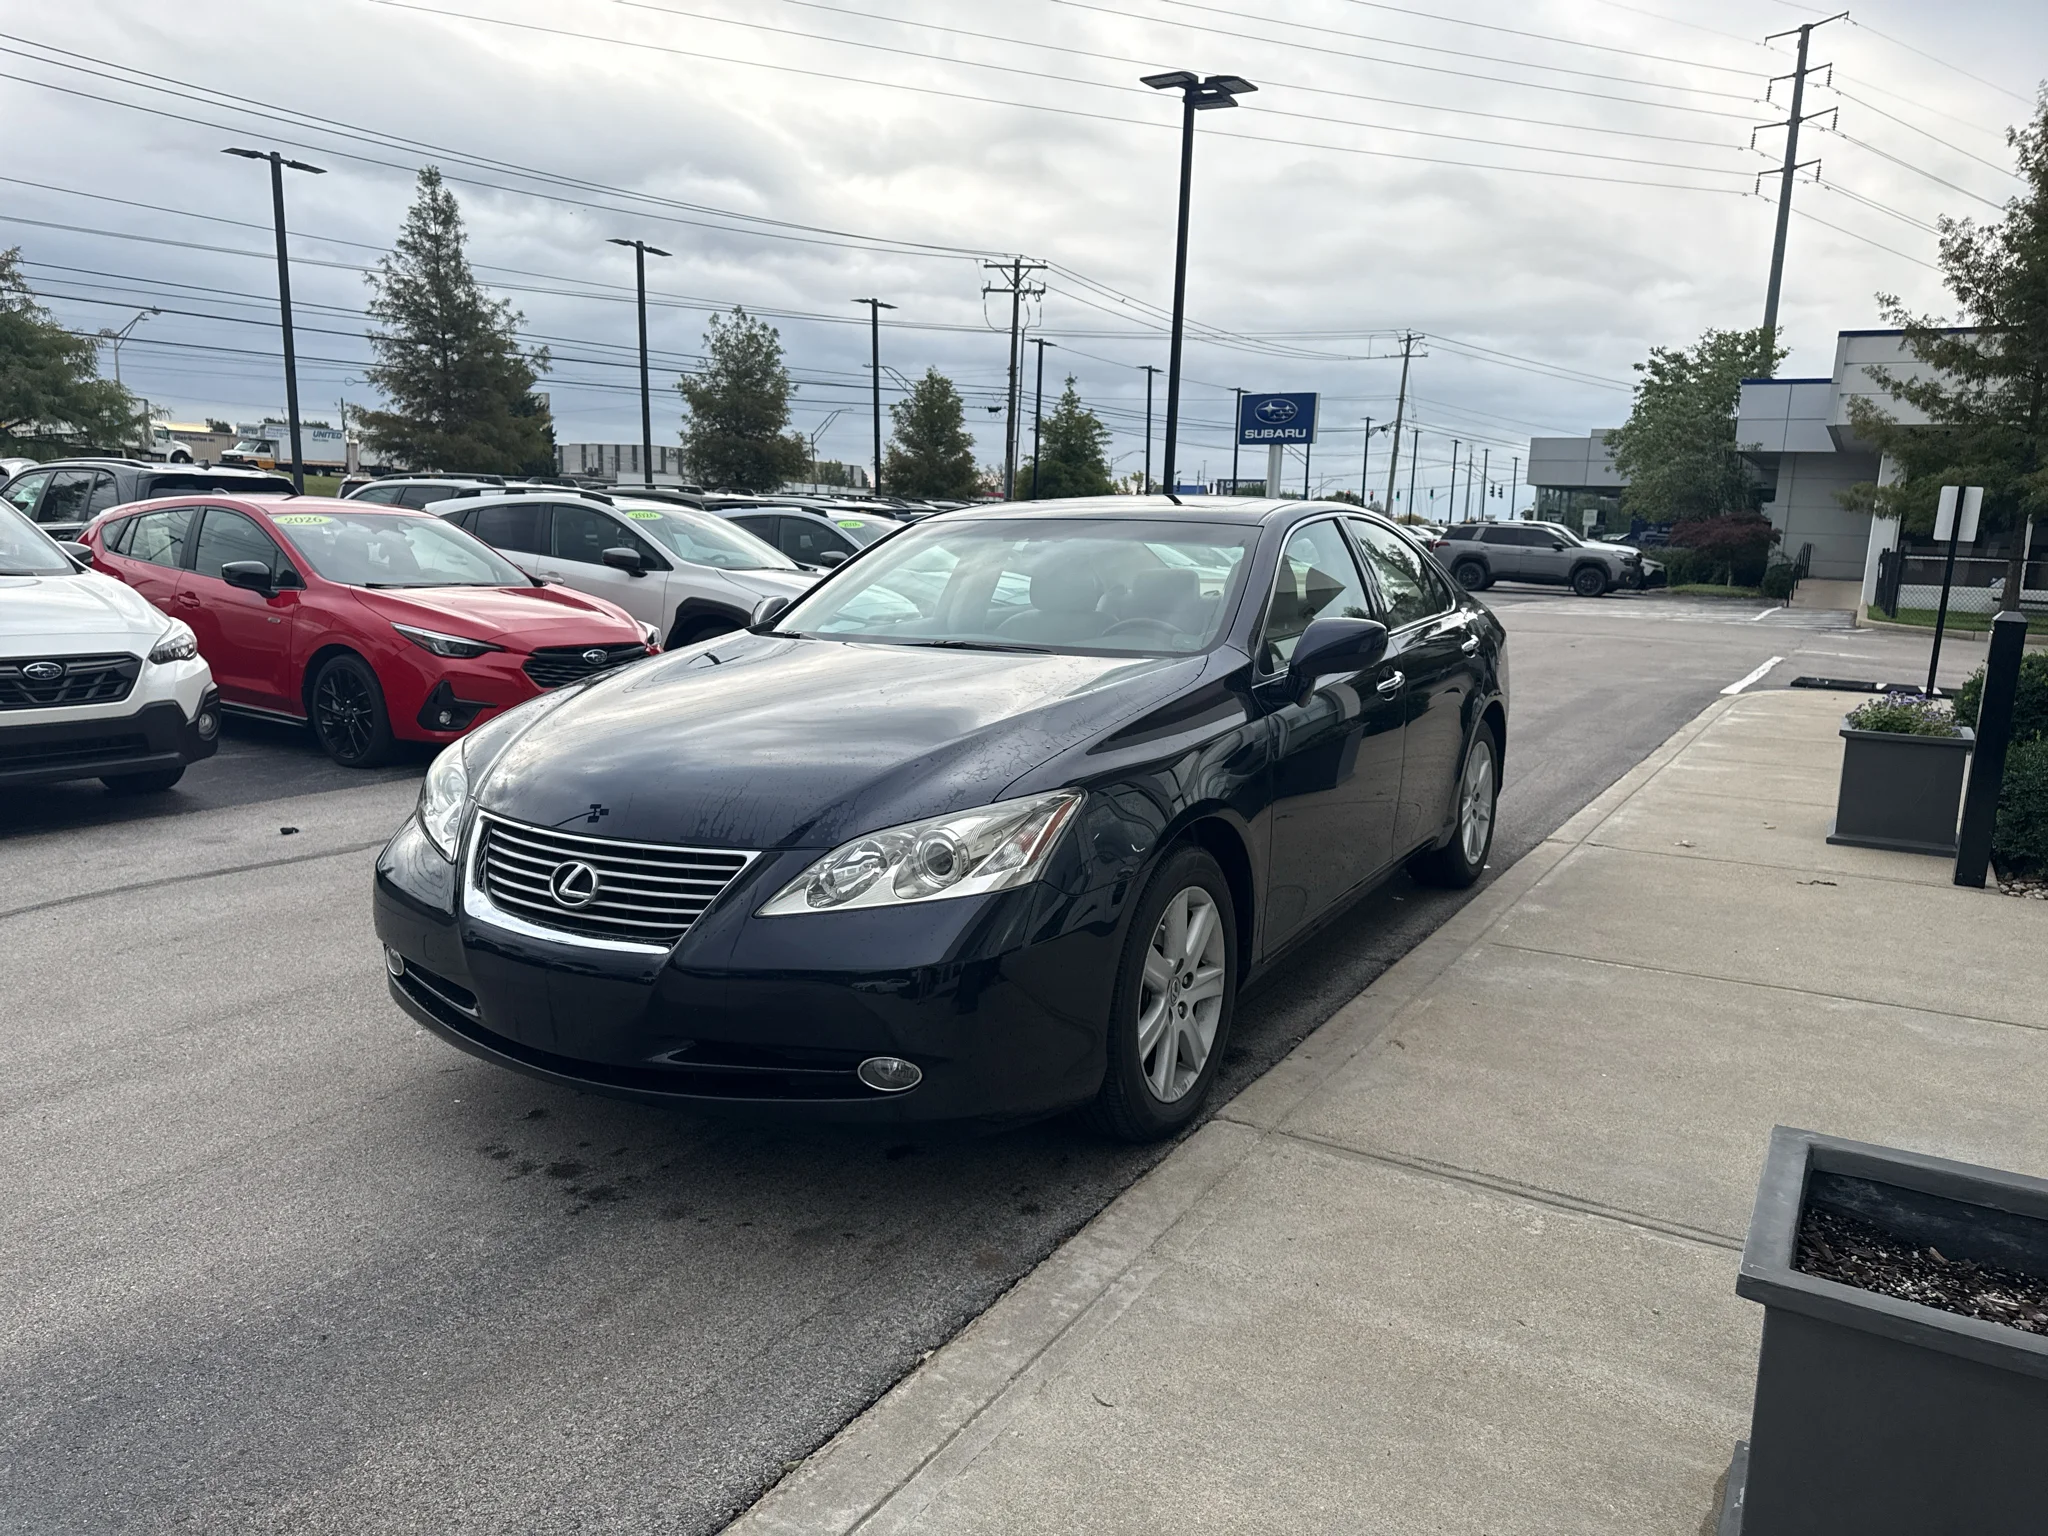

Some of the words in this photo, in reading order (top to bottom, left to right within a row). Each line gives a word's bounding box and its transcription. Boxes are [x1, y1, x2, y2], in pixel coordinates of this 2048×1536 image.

[313, 430, 342, 439] UNITED
[1244, 428, 1306, 439] SUBARU
[284, 516, 322, 524] 2026
